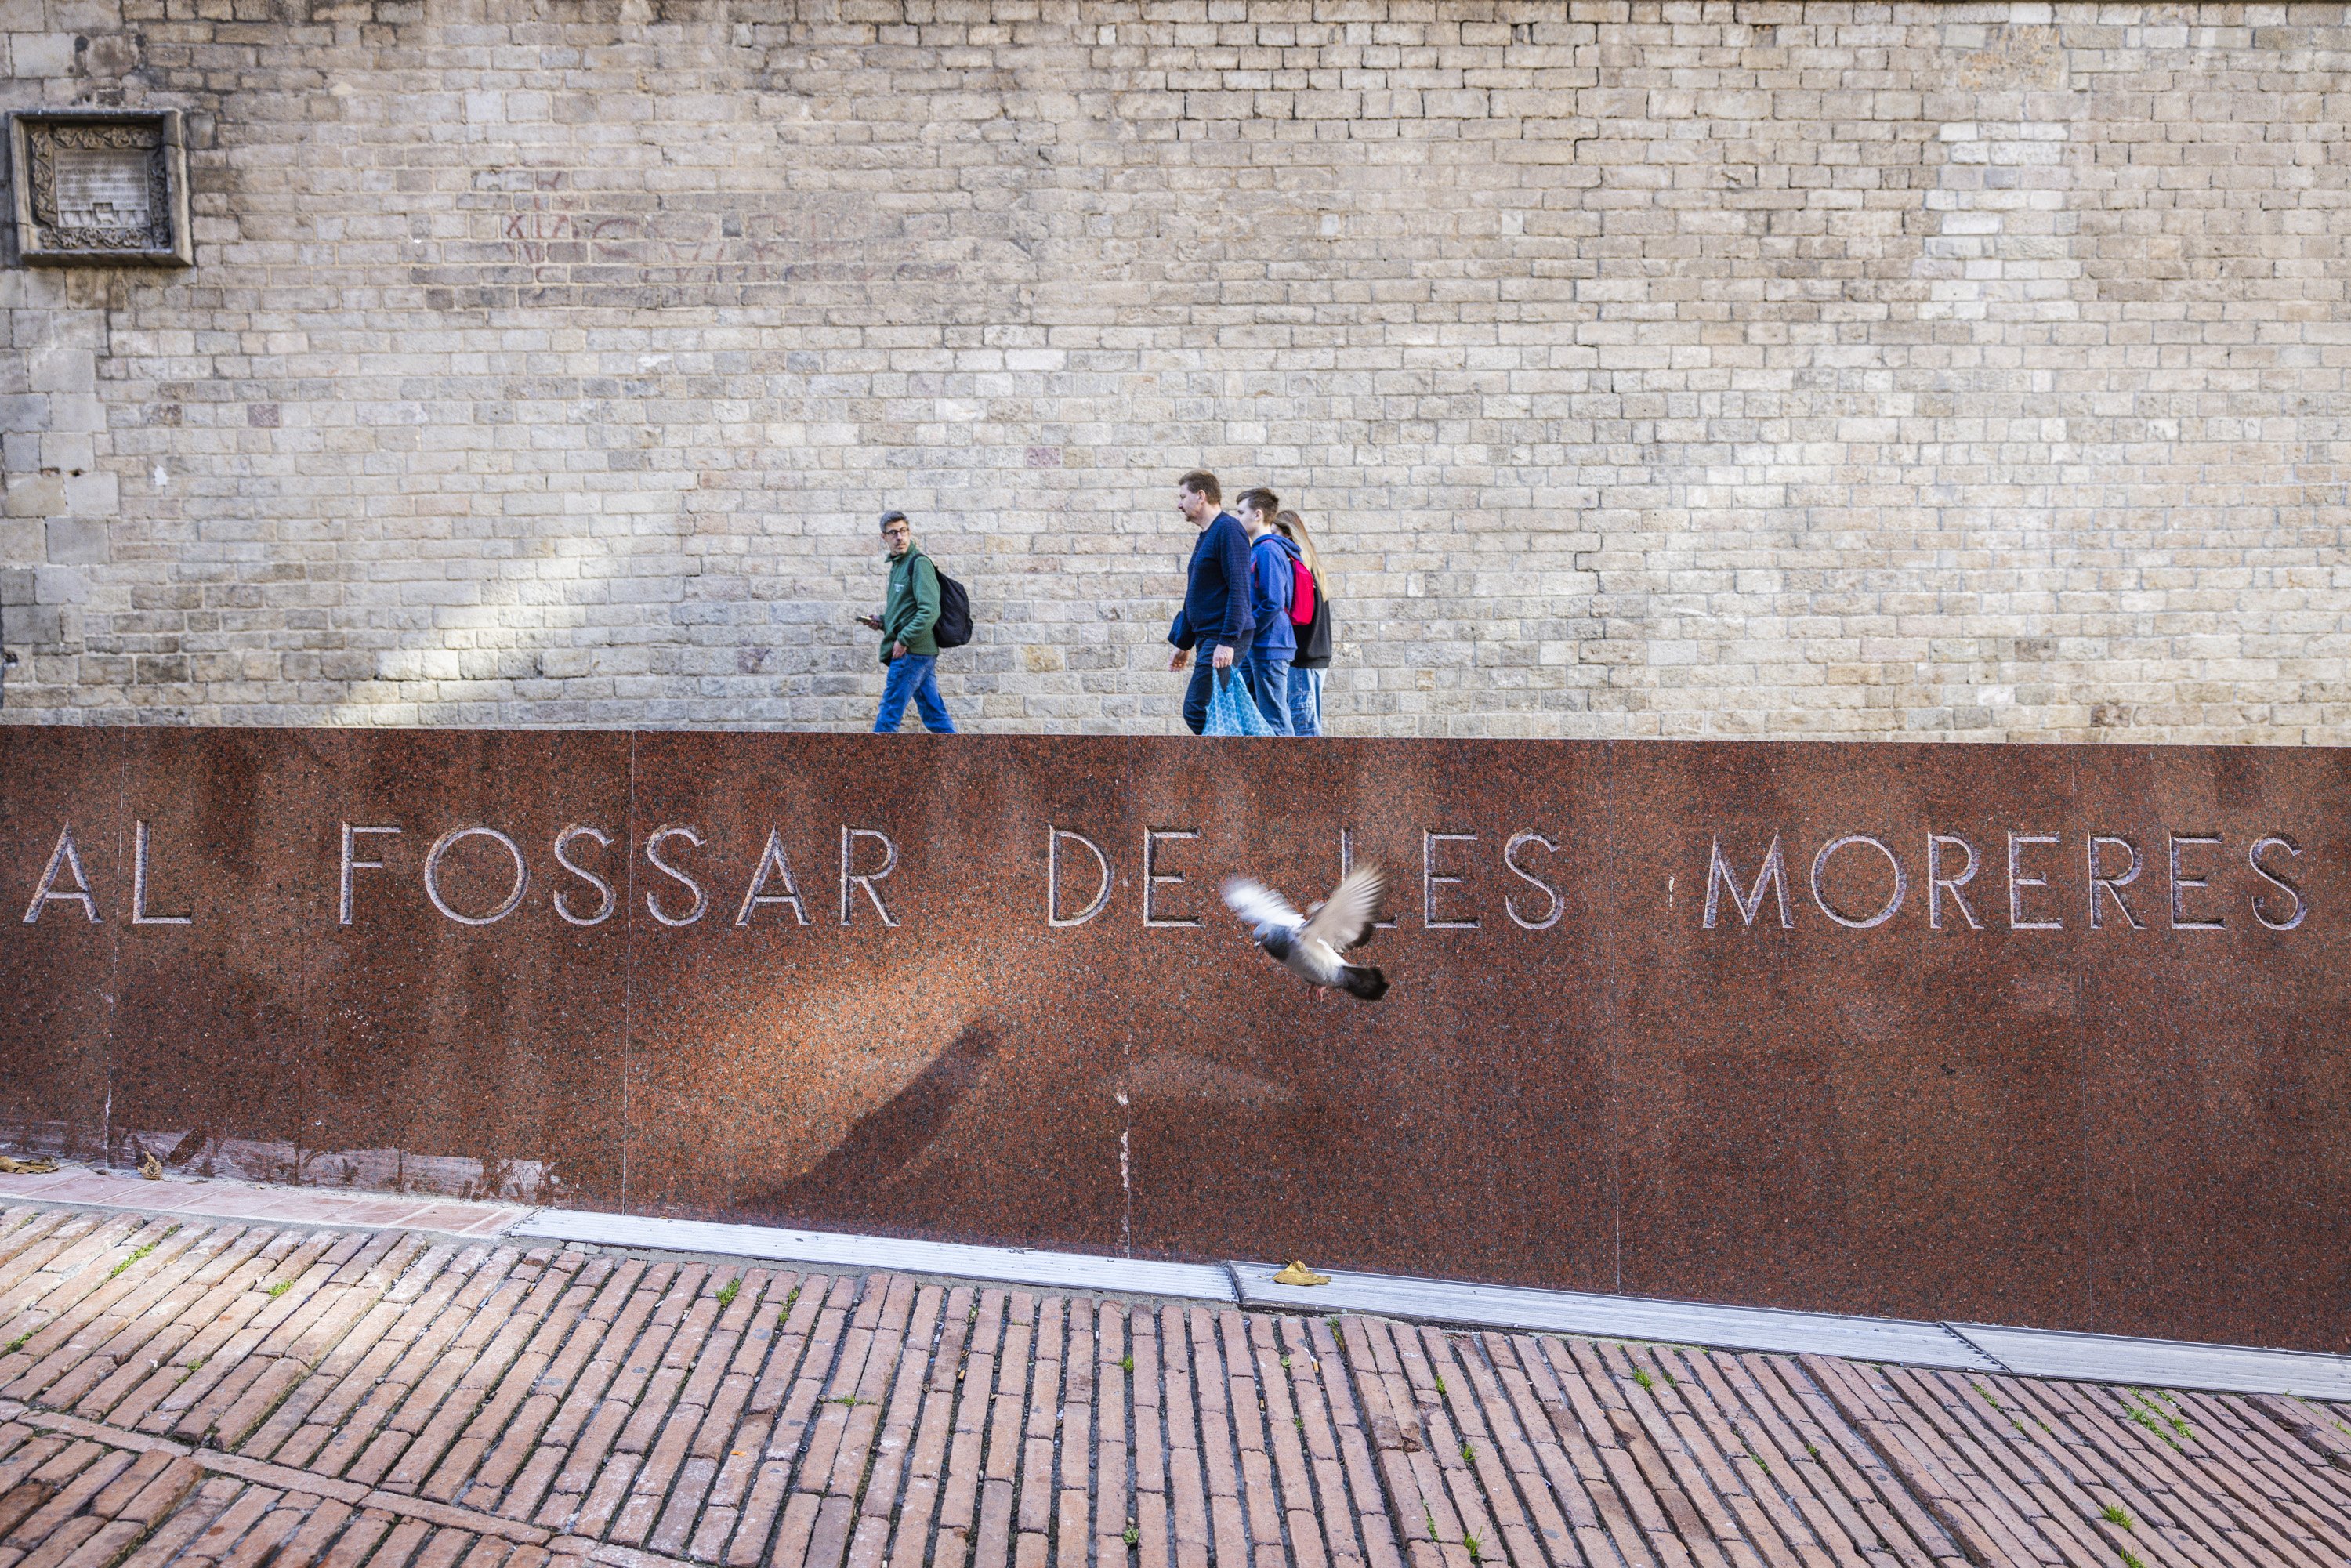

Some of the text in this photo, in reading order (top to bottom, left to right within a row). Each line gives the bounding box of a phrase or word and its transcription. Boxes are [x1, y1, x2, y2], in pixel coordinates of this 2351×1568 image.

[23, 820, 192, 925] AL
[339, 823, 900, 928] FOSSAR
[1049, 825, 1203, 928] DE
[1702, 830, 2308, 932] MORERES
